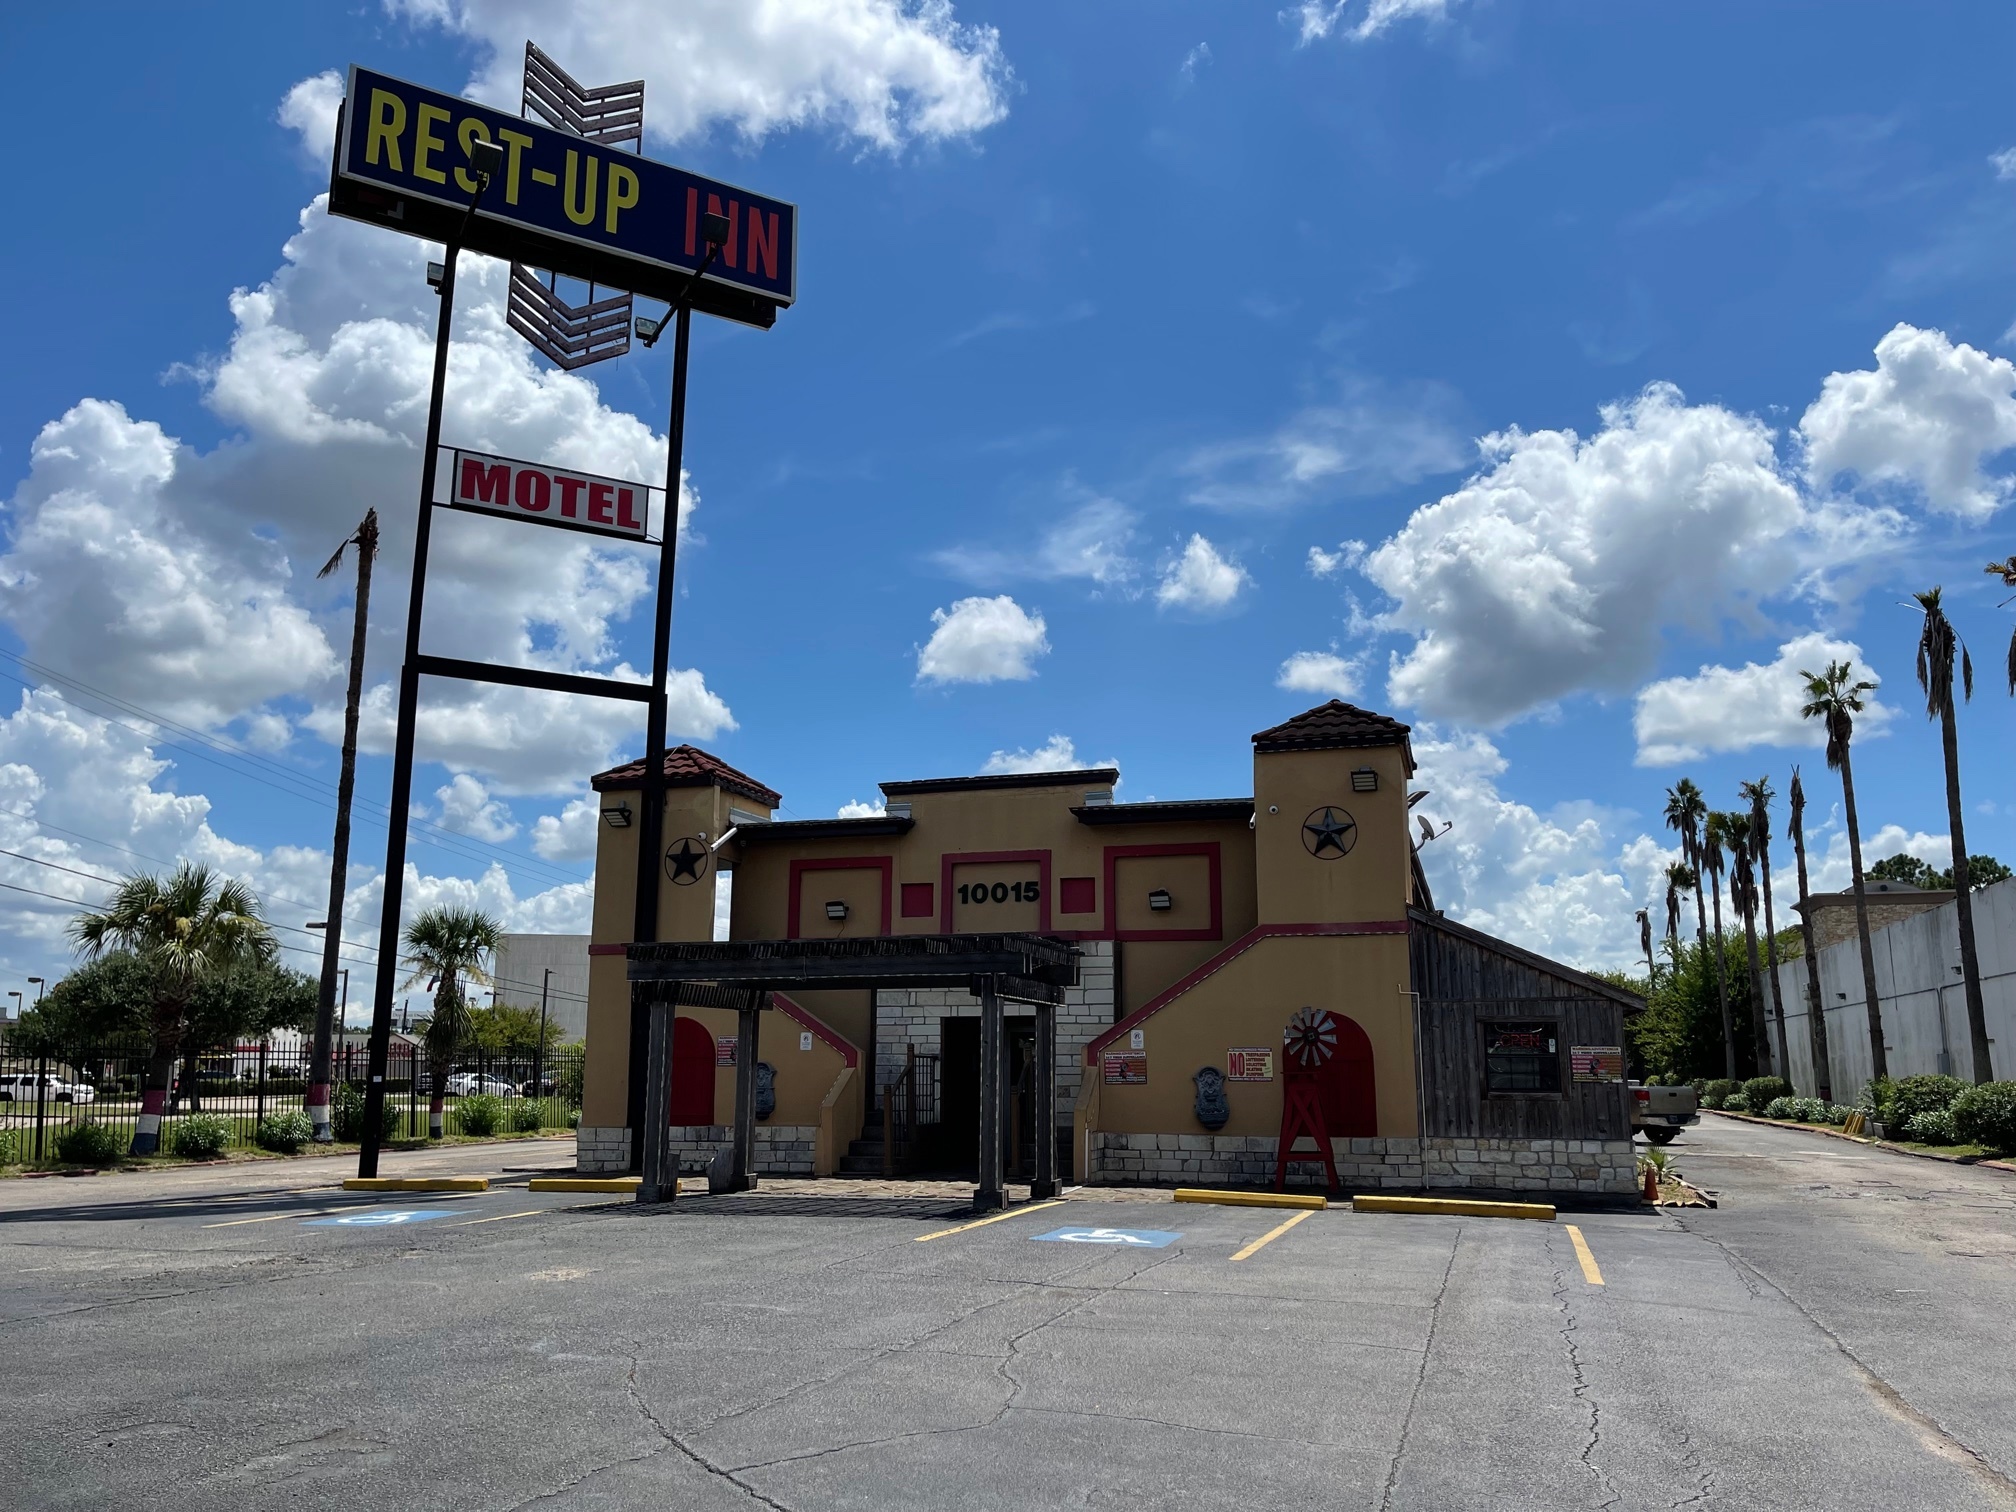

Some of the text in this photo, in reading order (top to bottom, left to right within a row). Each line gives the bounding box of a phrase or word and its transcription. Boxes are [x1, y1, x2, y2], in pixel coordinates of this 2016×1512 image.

[365, 88, 779, 280] REST-UP INN
[460, 458, 641, 530] MOTEL
[957, 881, 1040, 904] 10015
[1501, 1033, 1540, 1048] OPEN
[1228, 1052, 1245, 1077] NO
